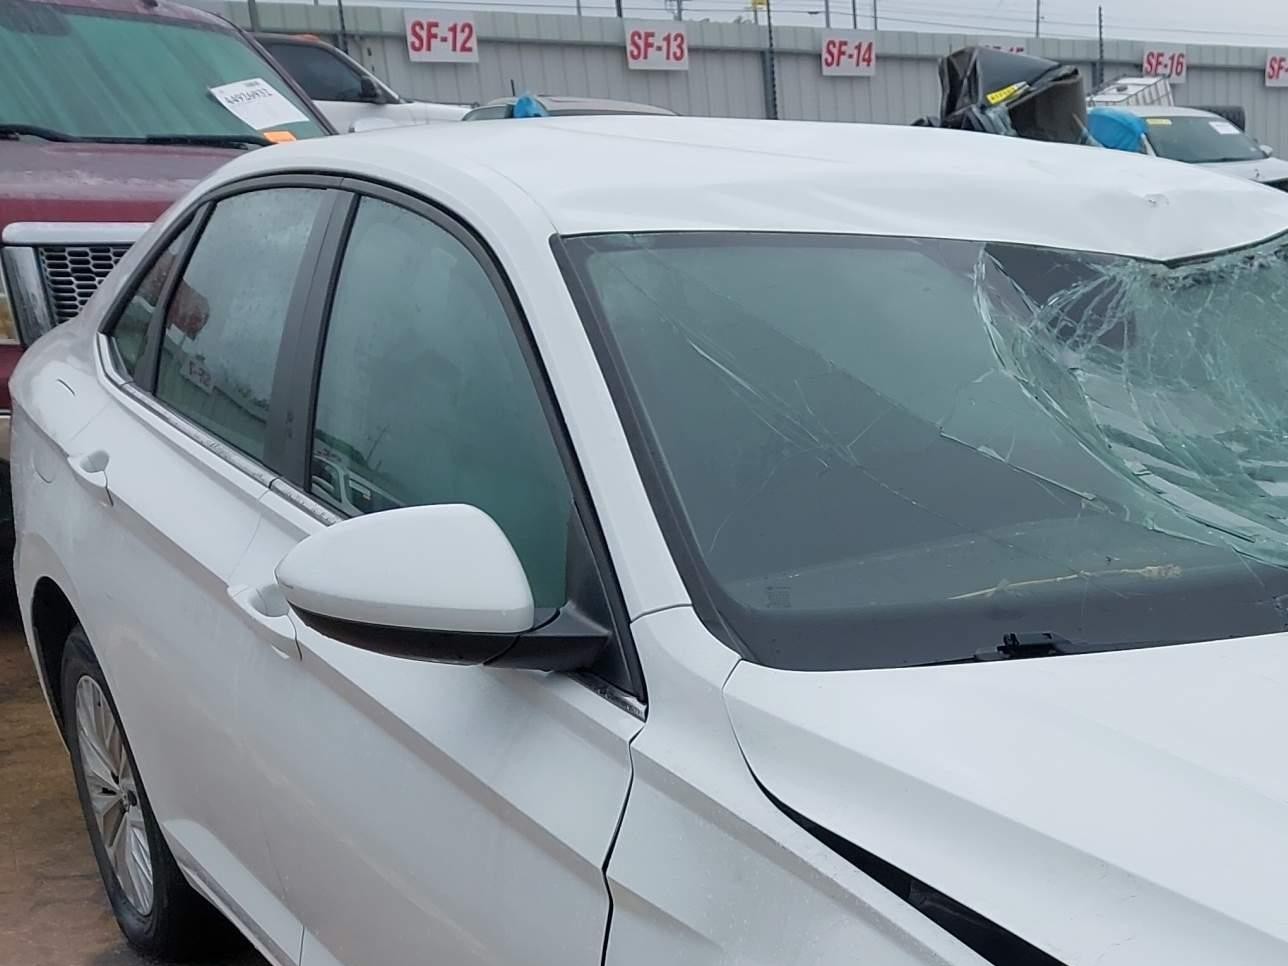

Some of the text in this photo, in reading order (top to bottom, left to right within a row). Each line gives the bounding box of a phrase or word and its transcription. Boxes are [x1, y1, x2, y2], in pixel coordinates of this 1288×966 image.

[410, 20, 473, 52] SF-12
[629, 30, 685, 61] SF-13
[824, 40, 873, 67] SF-14
[1145, 51, 1184, 77] SF-16
